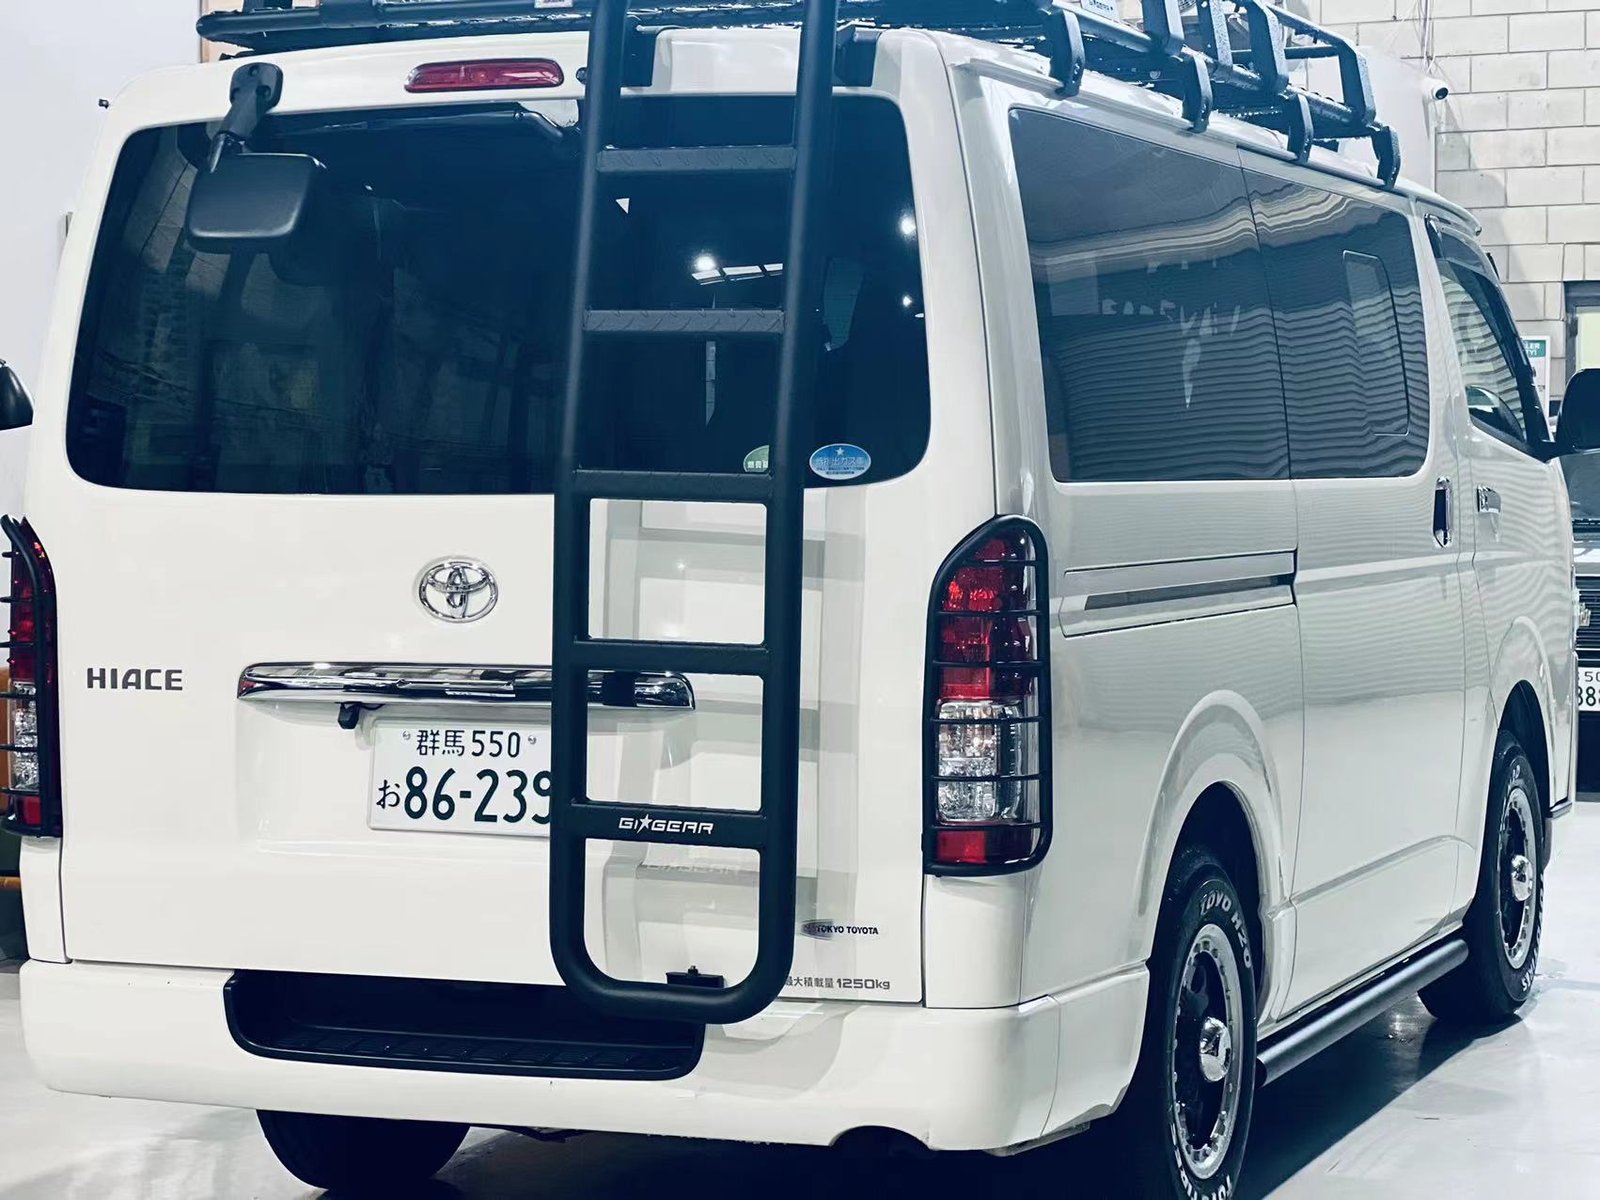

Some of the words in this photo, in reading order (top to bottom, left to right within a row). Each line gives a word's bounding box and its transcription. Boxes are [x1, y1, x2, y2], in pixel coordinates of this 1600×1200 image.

[87, 668, 183, 691] HIACE
[1200, 890, 1232, 916] TOYO
[816, 925, 845, 934] TOKYO
[846, 926, 879, 935] TOYOTA
[836, 978, 890, 990] 1250kg
